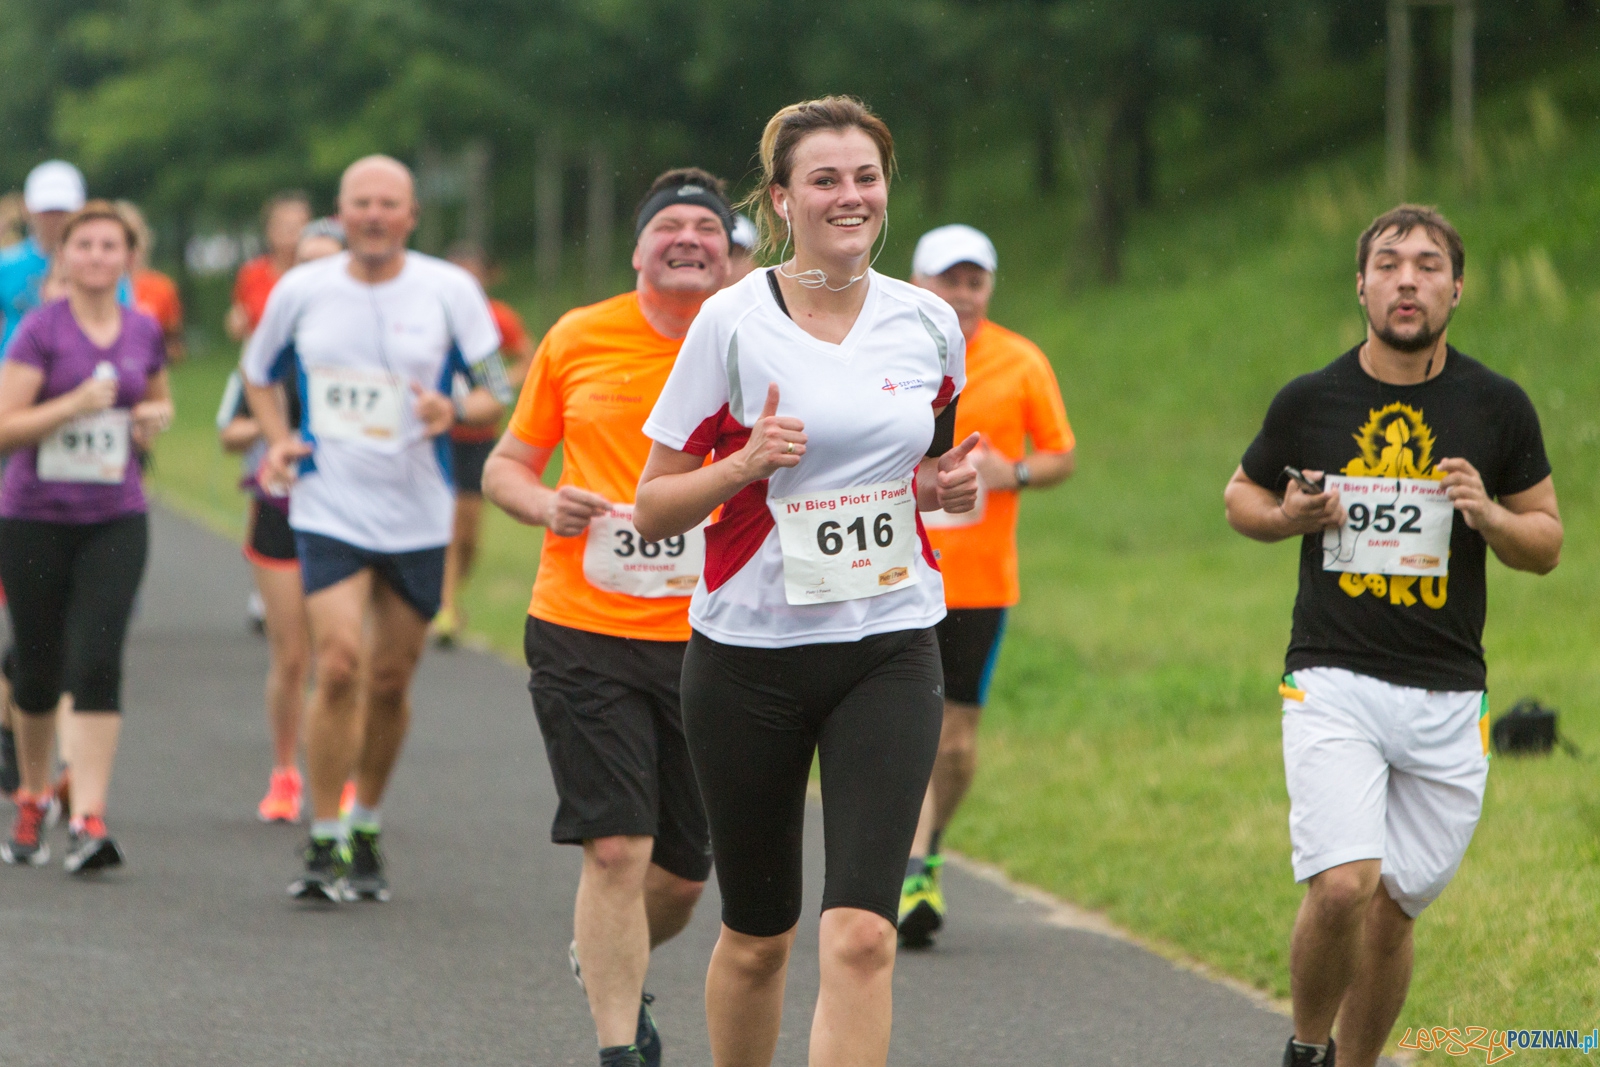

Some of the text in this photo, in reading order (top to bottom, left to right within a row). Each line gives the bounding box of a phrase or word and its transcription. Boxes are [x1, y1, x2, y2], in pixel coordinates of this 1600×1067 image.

[1343, 483, 1369, 494] Bieg
[1404, 484, 1407, 493] i
[787, 485, 908, 514] IV Bieg Piotr i Paweł
[610, 510, 632, 520] Bieg
[1348, 503, 1422, 534] 952
[816, 512, 894, 556] 616
[1367, 539, 1400, 548] DAWID
[613, 530, 686, 559] 369
[851, 558, 872, 569] ADA
